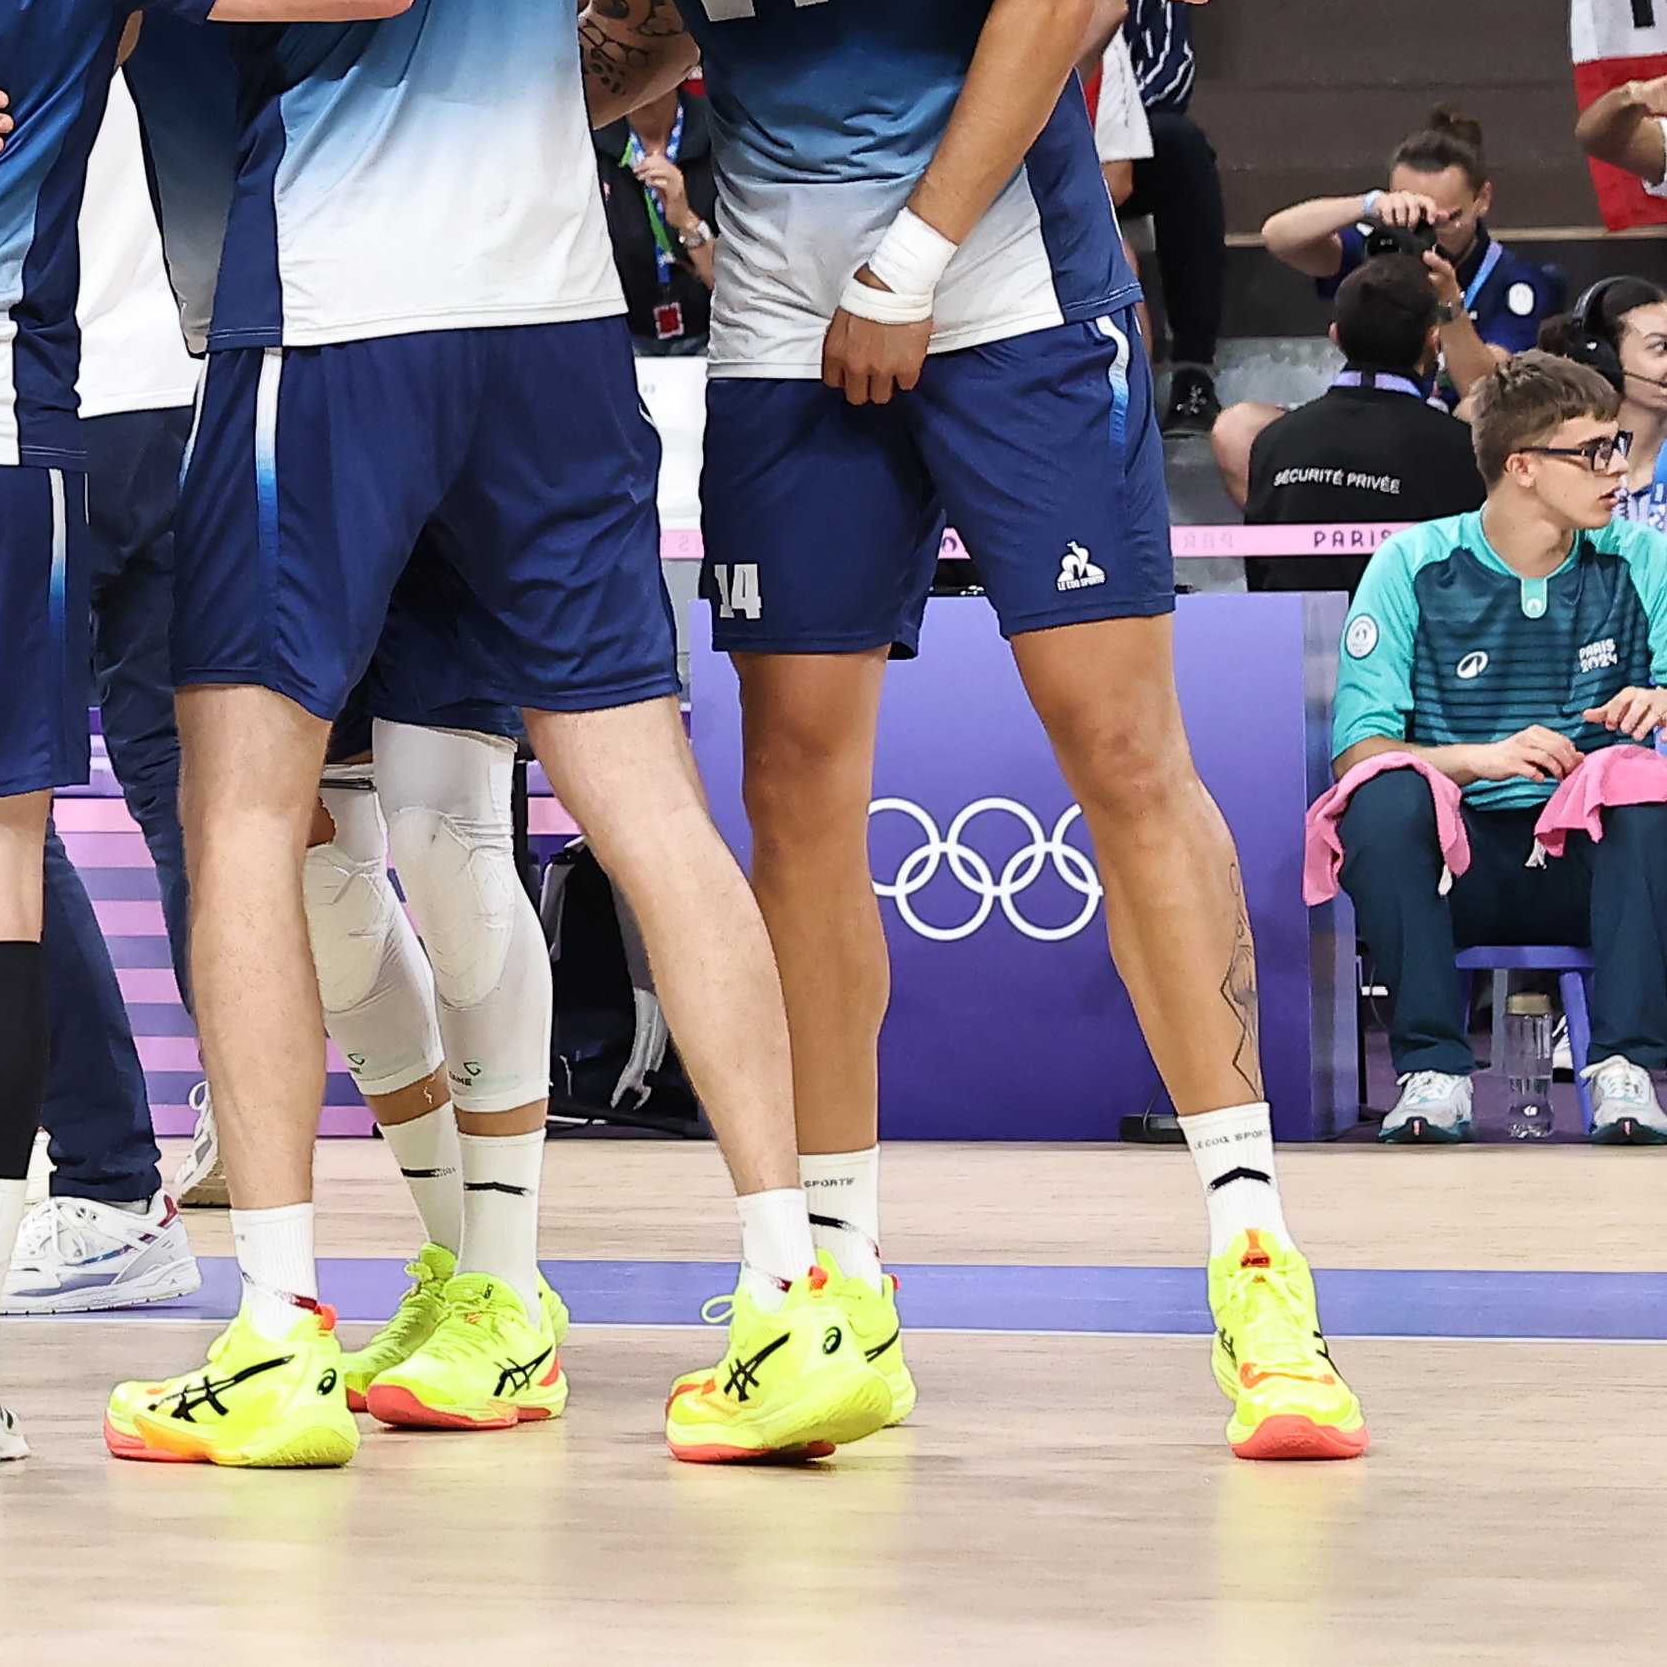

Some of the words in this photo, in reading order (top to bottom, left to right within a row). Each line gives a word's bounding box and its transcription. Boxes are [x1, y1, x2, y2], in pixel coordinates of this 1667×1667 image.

[714, 563, 762, 619] 14
[1578, 638, 1616, 660] PARIS
[1579, 652, 1618, 674] 2024
[803, 1177, 855, 1188] SPORTIF
